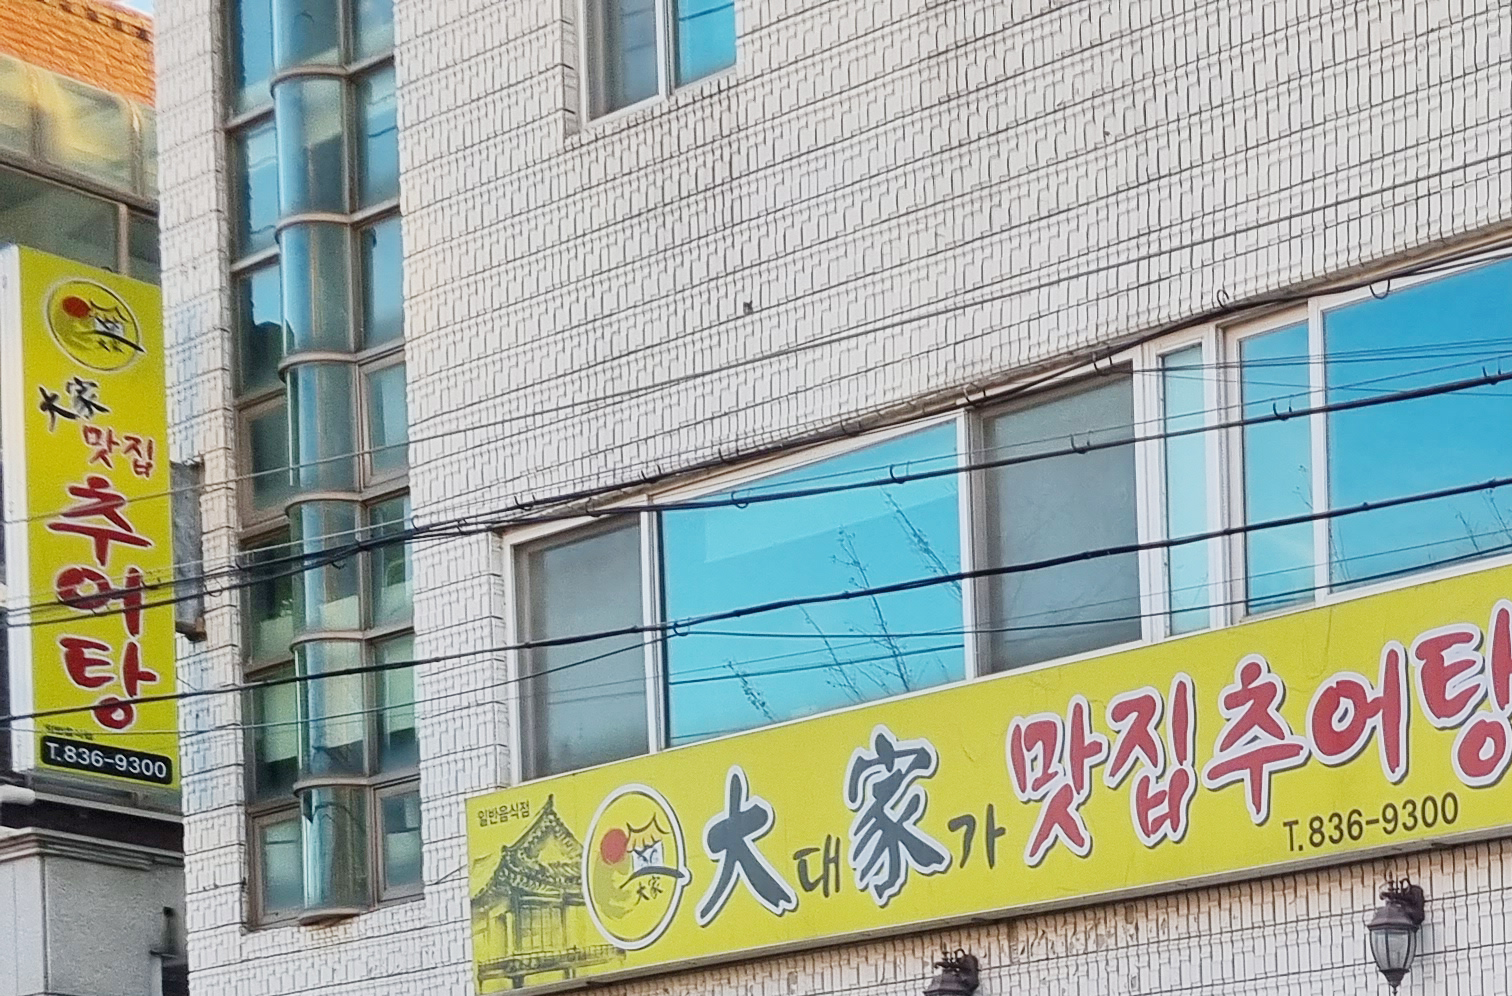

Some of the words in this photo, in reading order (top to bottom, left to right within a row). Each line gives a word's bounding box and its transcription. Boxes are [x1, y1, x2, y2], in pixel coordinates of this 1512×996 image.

[82, 424, 154, 478] 맛집
[47, 475, 158, 730] 추어탕
[45, 741, 167, 778] T.836-9300
[478, 800, 530, 827] 일반음식점
[1283, 792, 1460, 852] T.836-9300
